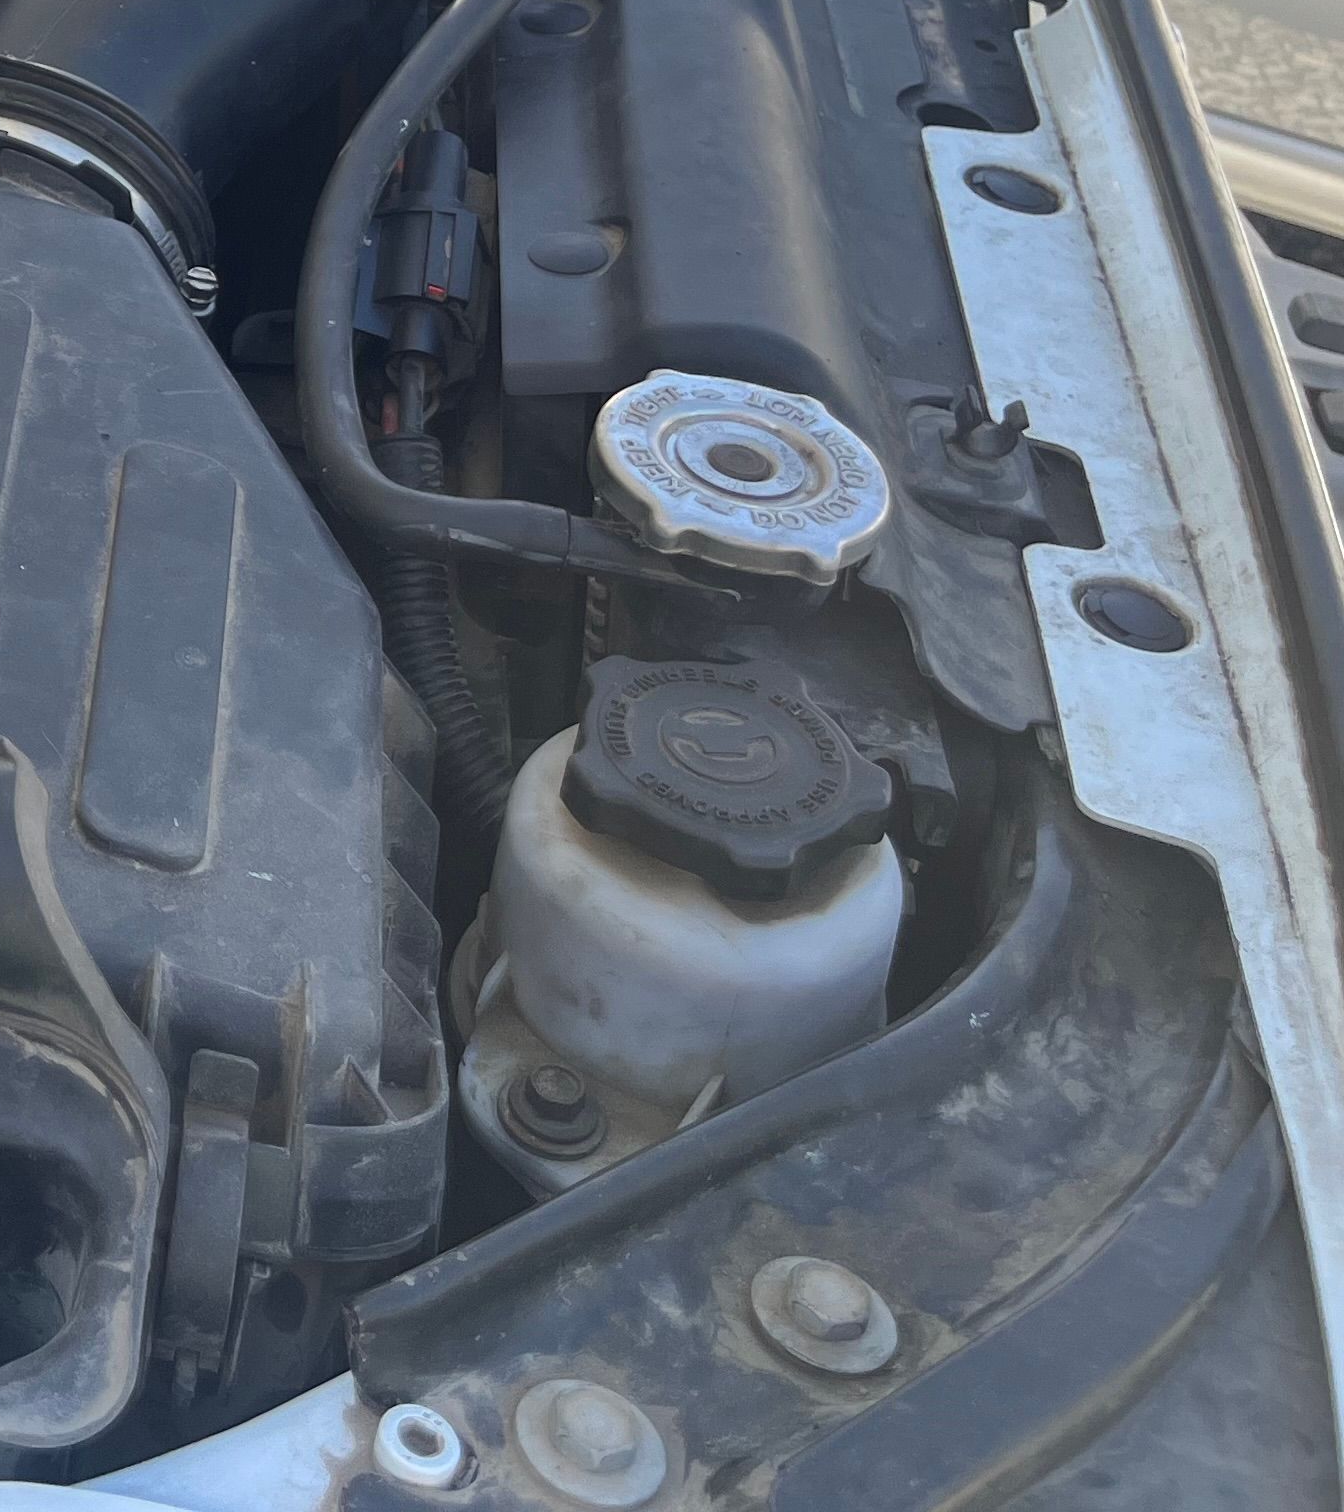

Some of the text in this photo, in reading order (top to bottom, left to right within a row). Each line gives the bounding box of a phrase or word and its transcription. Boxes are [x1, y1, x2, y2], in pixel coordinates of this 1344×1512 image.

[619, 387, 692, 498] KEEP TIGHT
[745, 391, 869, 530] DO NOT OPEN HOT
[605, 667, 843, 766] POWER STEERING FLUID
[636, 772, 840, 825] USE APPROVED
